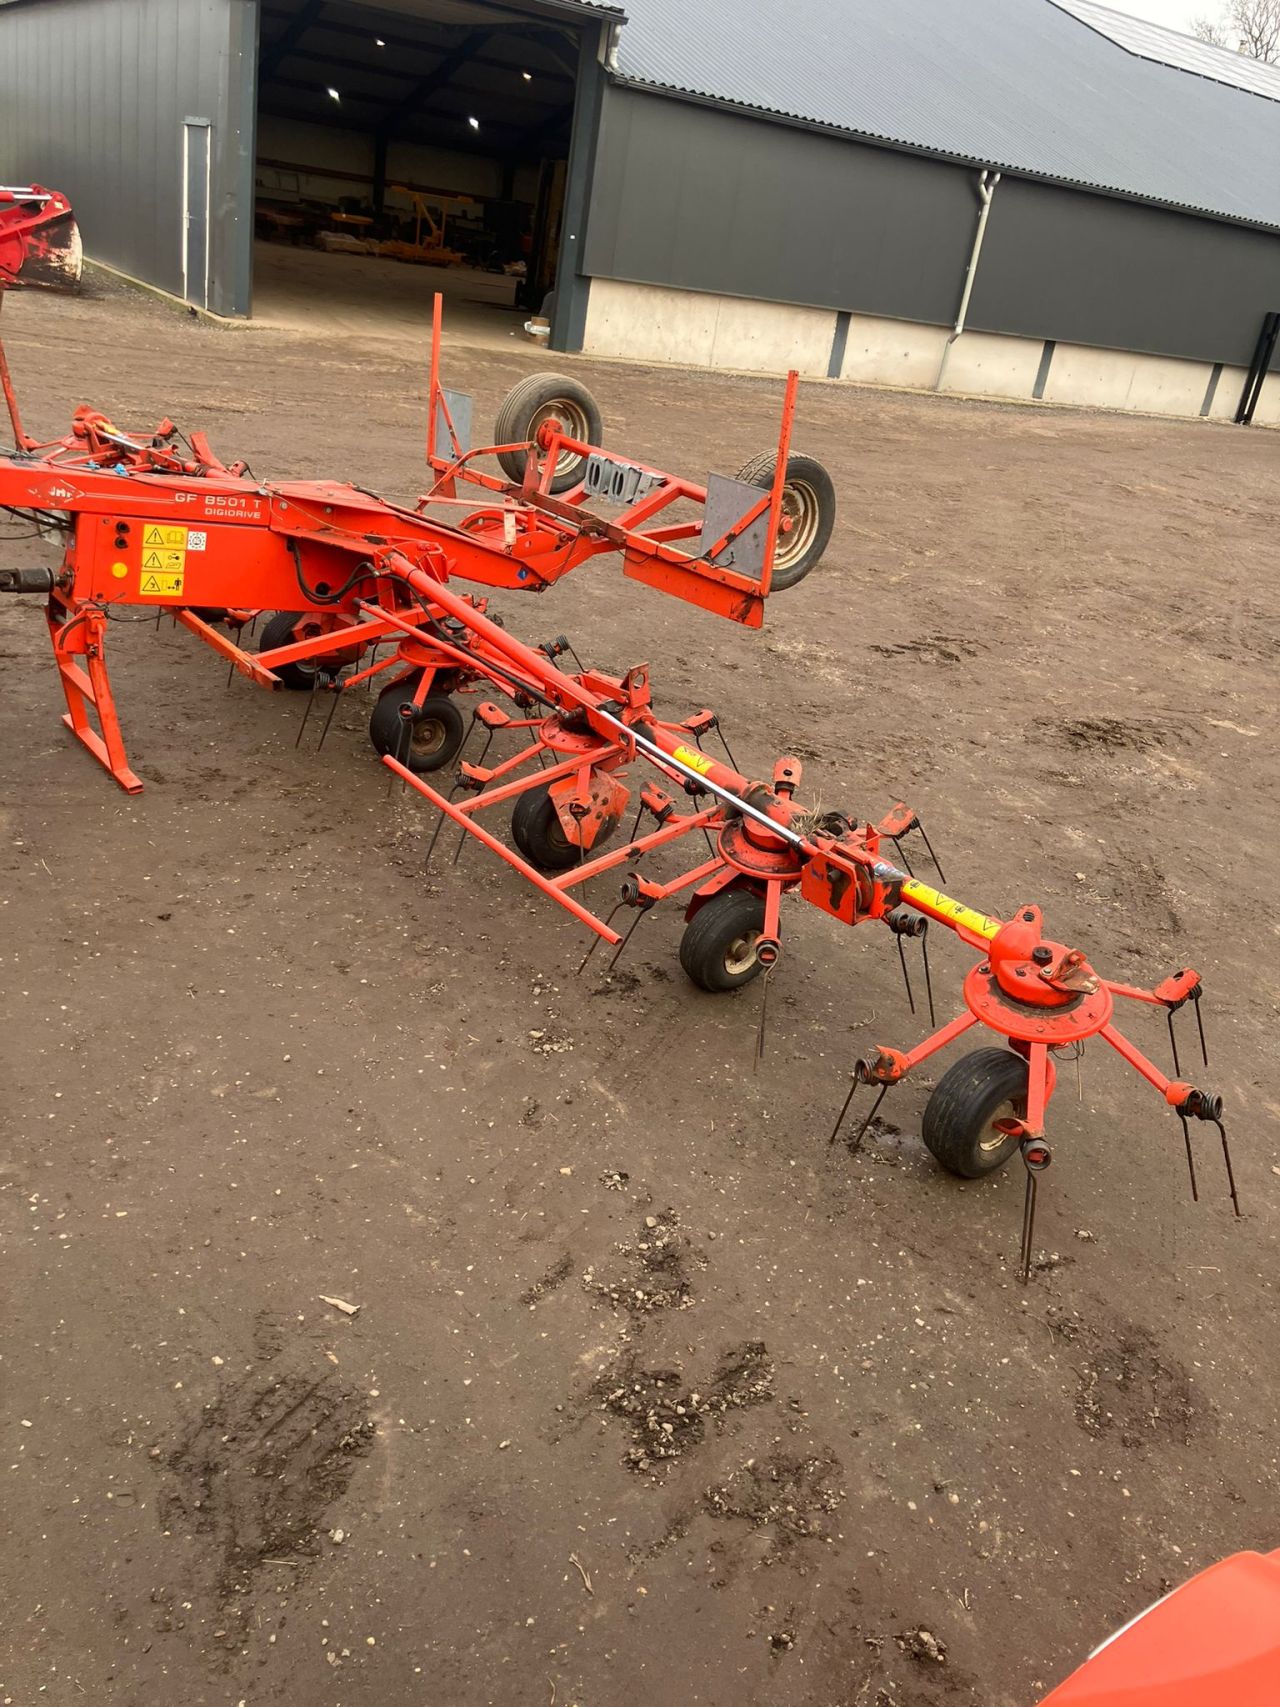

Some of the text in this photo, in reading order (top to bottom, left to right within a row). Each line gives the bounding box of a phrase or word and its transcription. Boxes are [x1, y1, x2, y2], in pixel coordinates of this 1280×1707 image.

[175, 493, 262, 508] GF 8501 T
[204, 507, 261, 519] DIGIDRIVE
